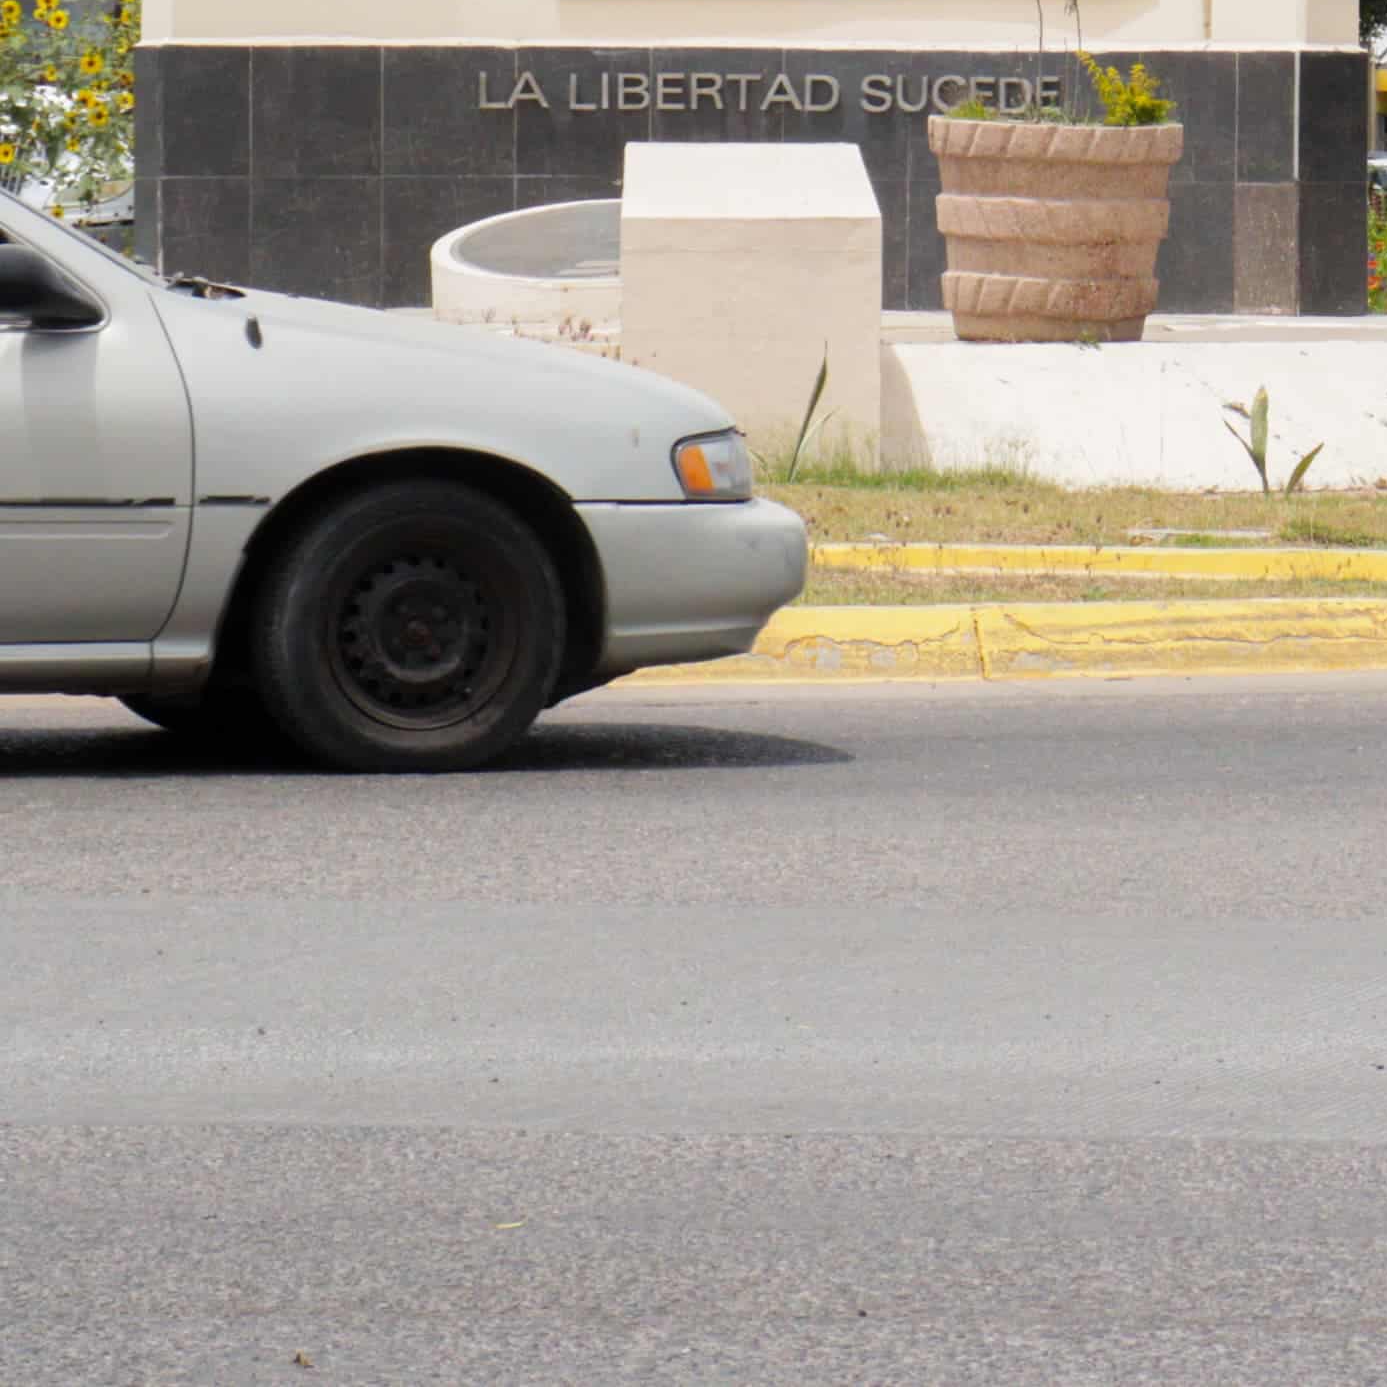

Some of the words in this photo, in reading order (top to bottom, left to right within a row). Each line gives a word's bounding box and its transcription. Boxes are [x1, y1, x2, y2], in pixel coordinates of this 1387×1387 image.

[479, 70, 549, 110] LA
[568, 71, 841, 112] LIBERTAD
[860, 73, 1060, 114] SUCEDE
